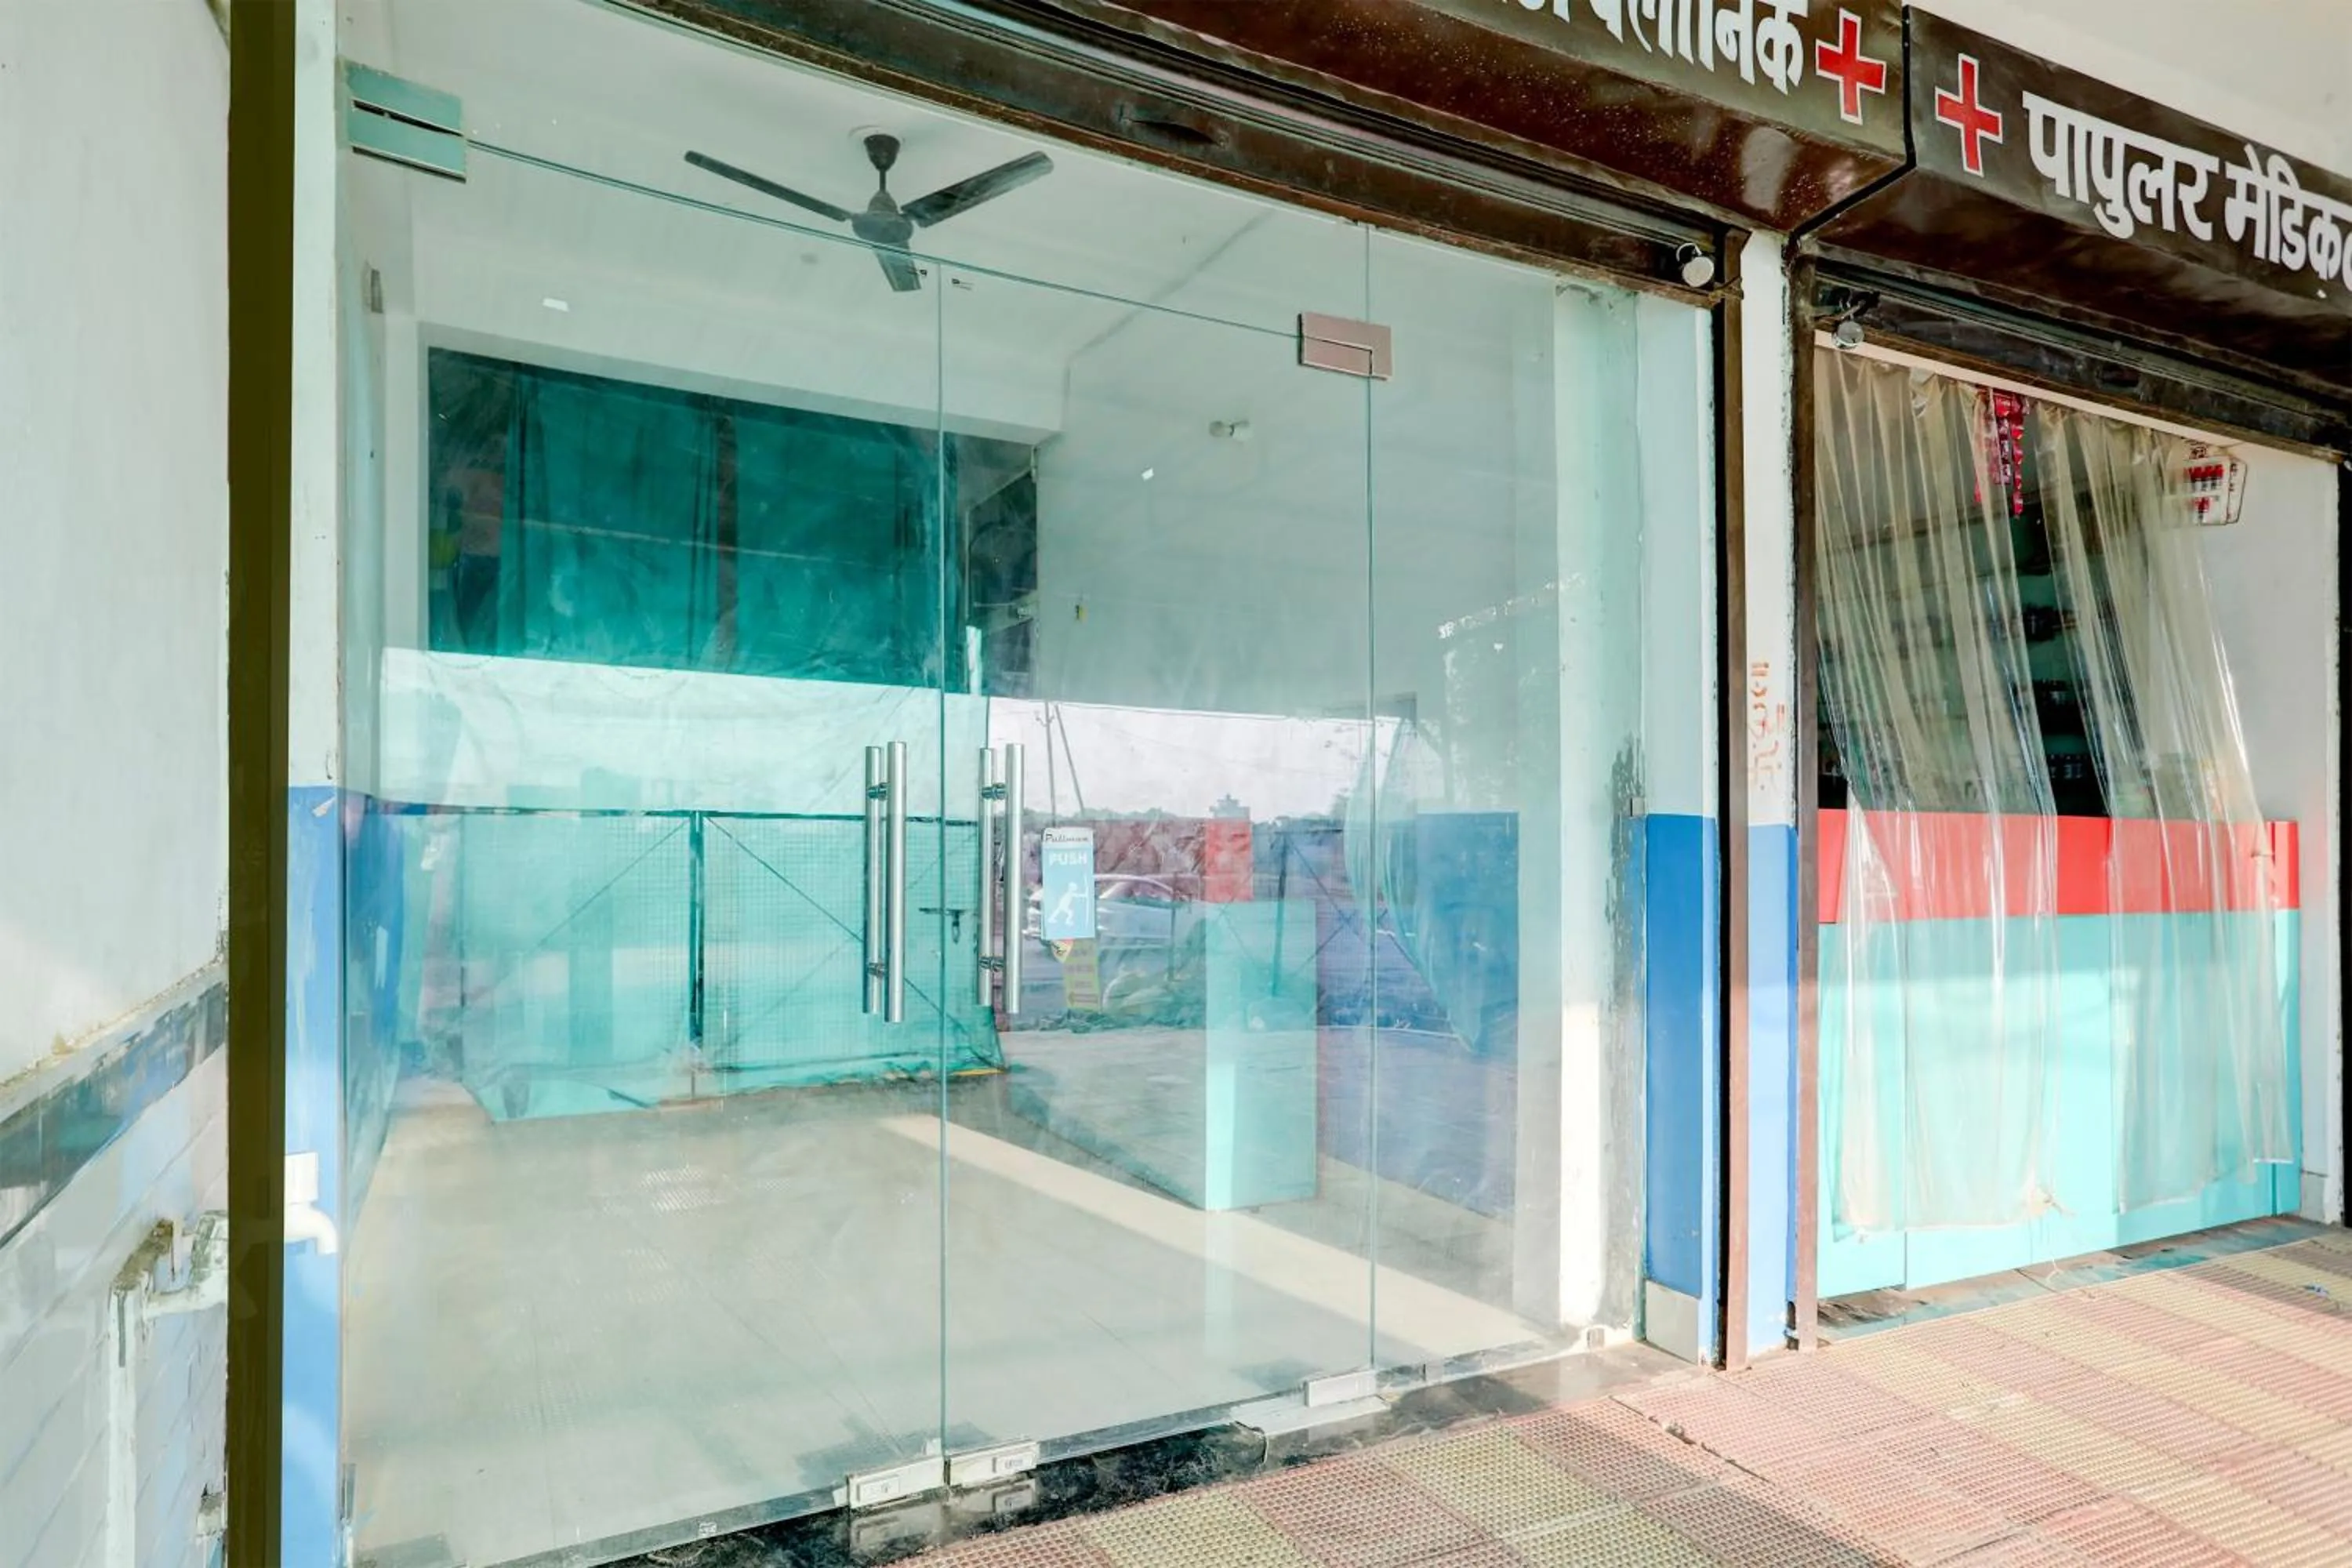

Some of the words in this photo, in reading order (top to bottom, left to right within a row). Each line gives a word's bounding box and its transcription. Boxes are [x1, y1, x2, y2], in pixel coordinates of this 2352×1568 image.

[2022, 91, 2220, 239] पापुलर
[2224, 143, 2352, 292] मेडिक
[1049, 851, 1087, 866] PUSH
